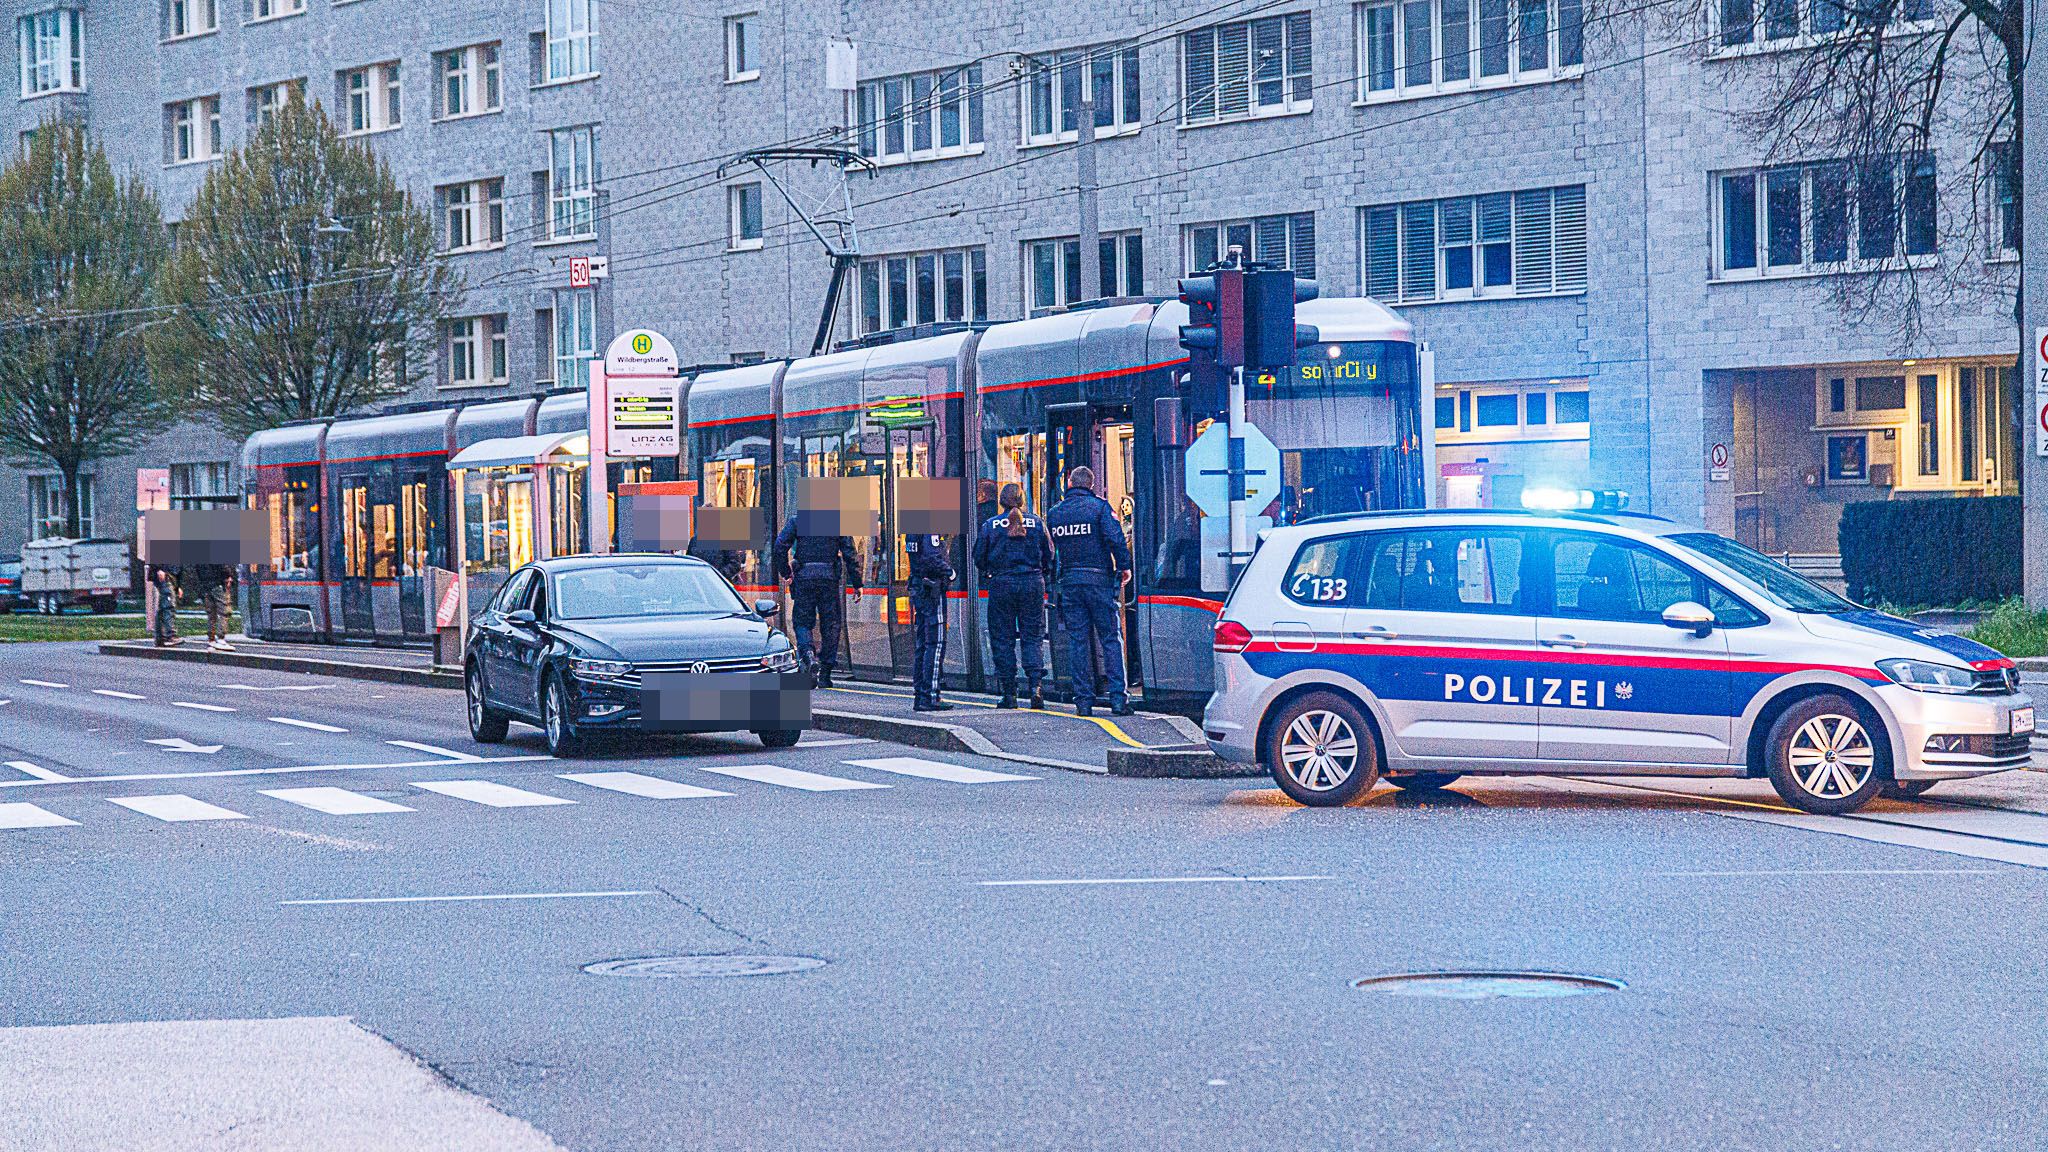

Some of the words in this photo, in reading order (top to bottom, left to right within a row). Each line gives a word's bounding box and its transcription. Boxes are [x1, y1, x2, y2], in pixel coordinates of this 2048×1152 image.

[573, 263, 587, 282] 50
[617, 356, 669, 364] Wildbergstraße
[992, 518, 1036, 529] POZEI
[1051, 523, 1092, 538] POLIZEI
[1311, 578, 1348, 601] 133
[1444, 673, 1606, 708] POLIZEI
